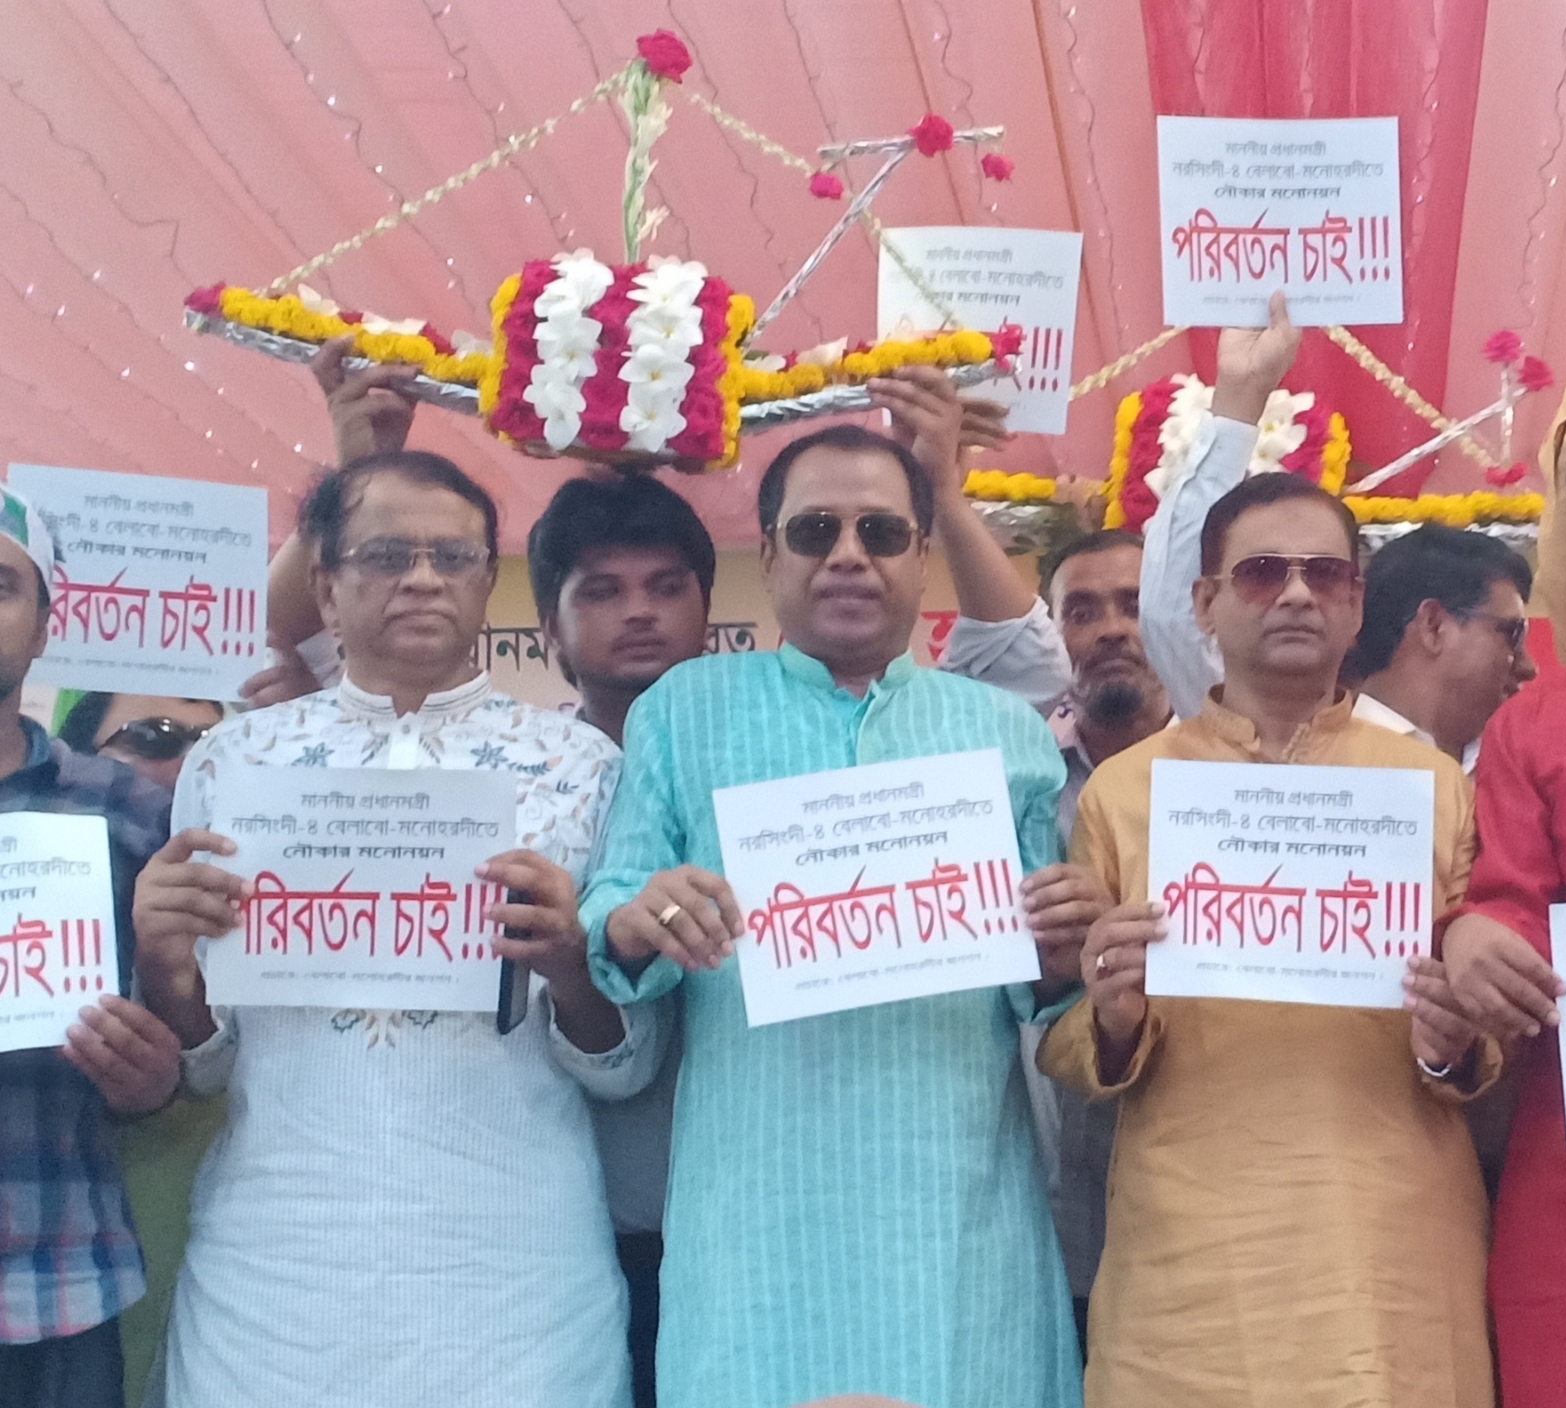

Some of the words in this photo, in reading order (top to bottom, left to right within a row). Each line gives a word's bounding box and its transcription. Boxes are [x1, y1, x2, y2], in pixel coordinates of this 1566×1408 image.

[1172, 207, 1290, 283] পরিবর্তন
[747, 864, 902, 969] পরিবর্তন
[1162, 862, 1306, 952] পরিবর্তন
